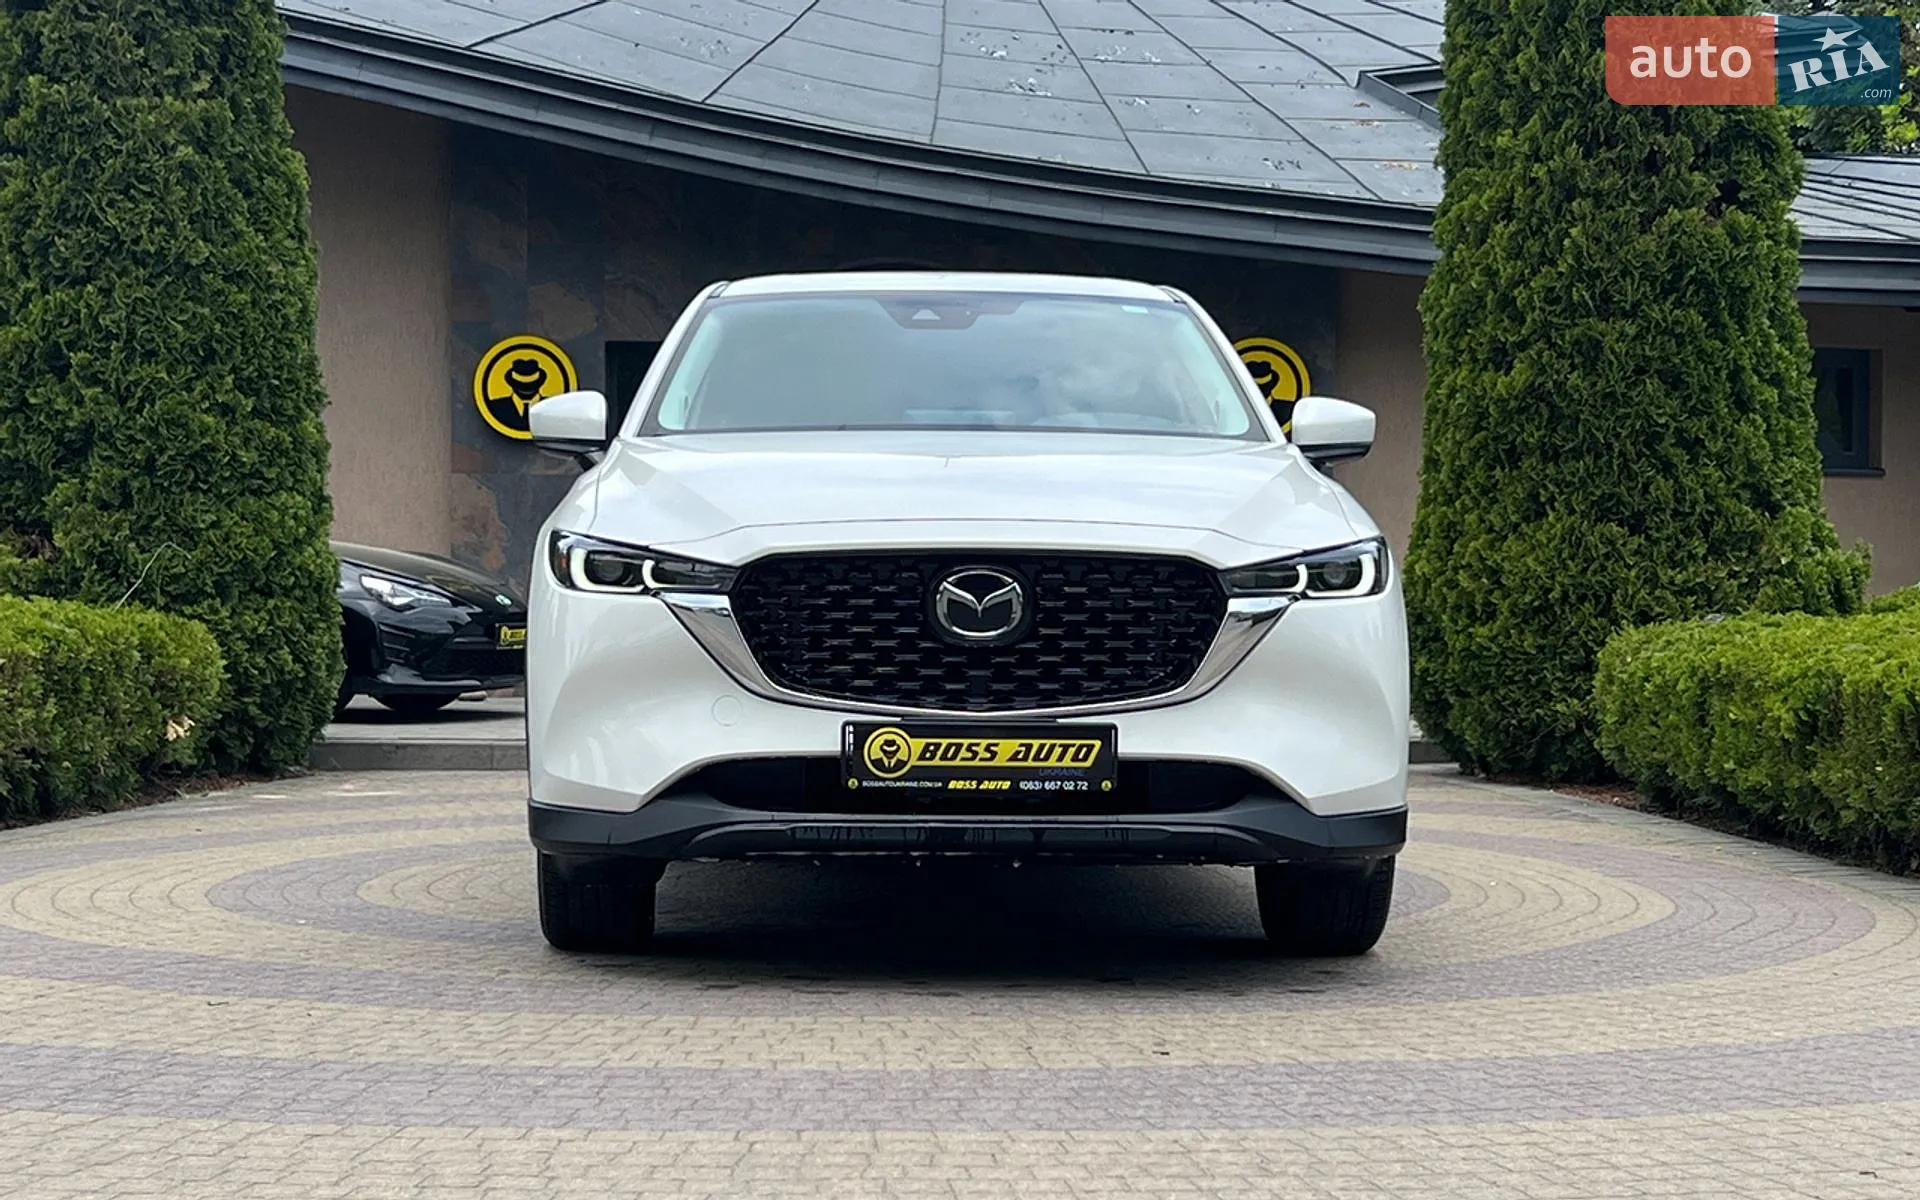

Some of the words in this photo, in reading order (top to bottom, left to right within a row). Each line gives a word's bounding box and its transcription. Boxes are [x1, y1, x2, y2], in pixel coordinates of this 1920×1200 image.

[917, 742, 999, 762] BOSS
[1006, 742, 1096, 762] AUTO
[947, 780, 977, 790] BOSS
[979, 780, 1011, 790] AUTO
[1063, 780, 1076, 790] 02
[1077, 780, 1089, 790] 72
